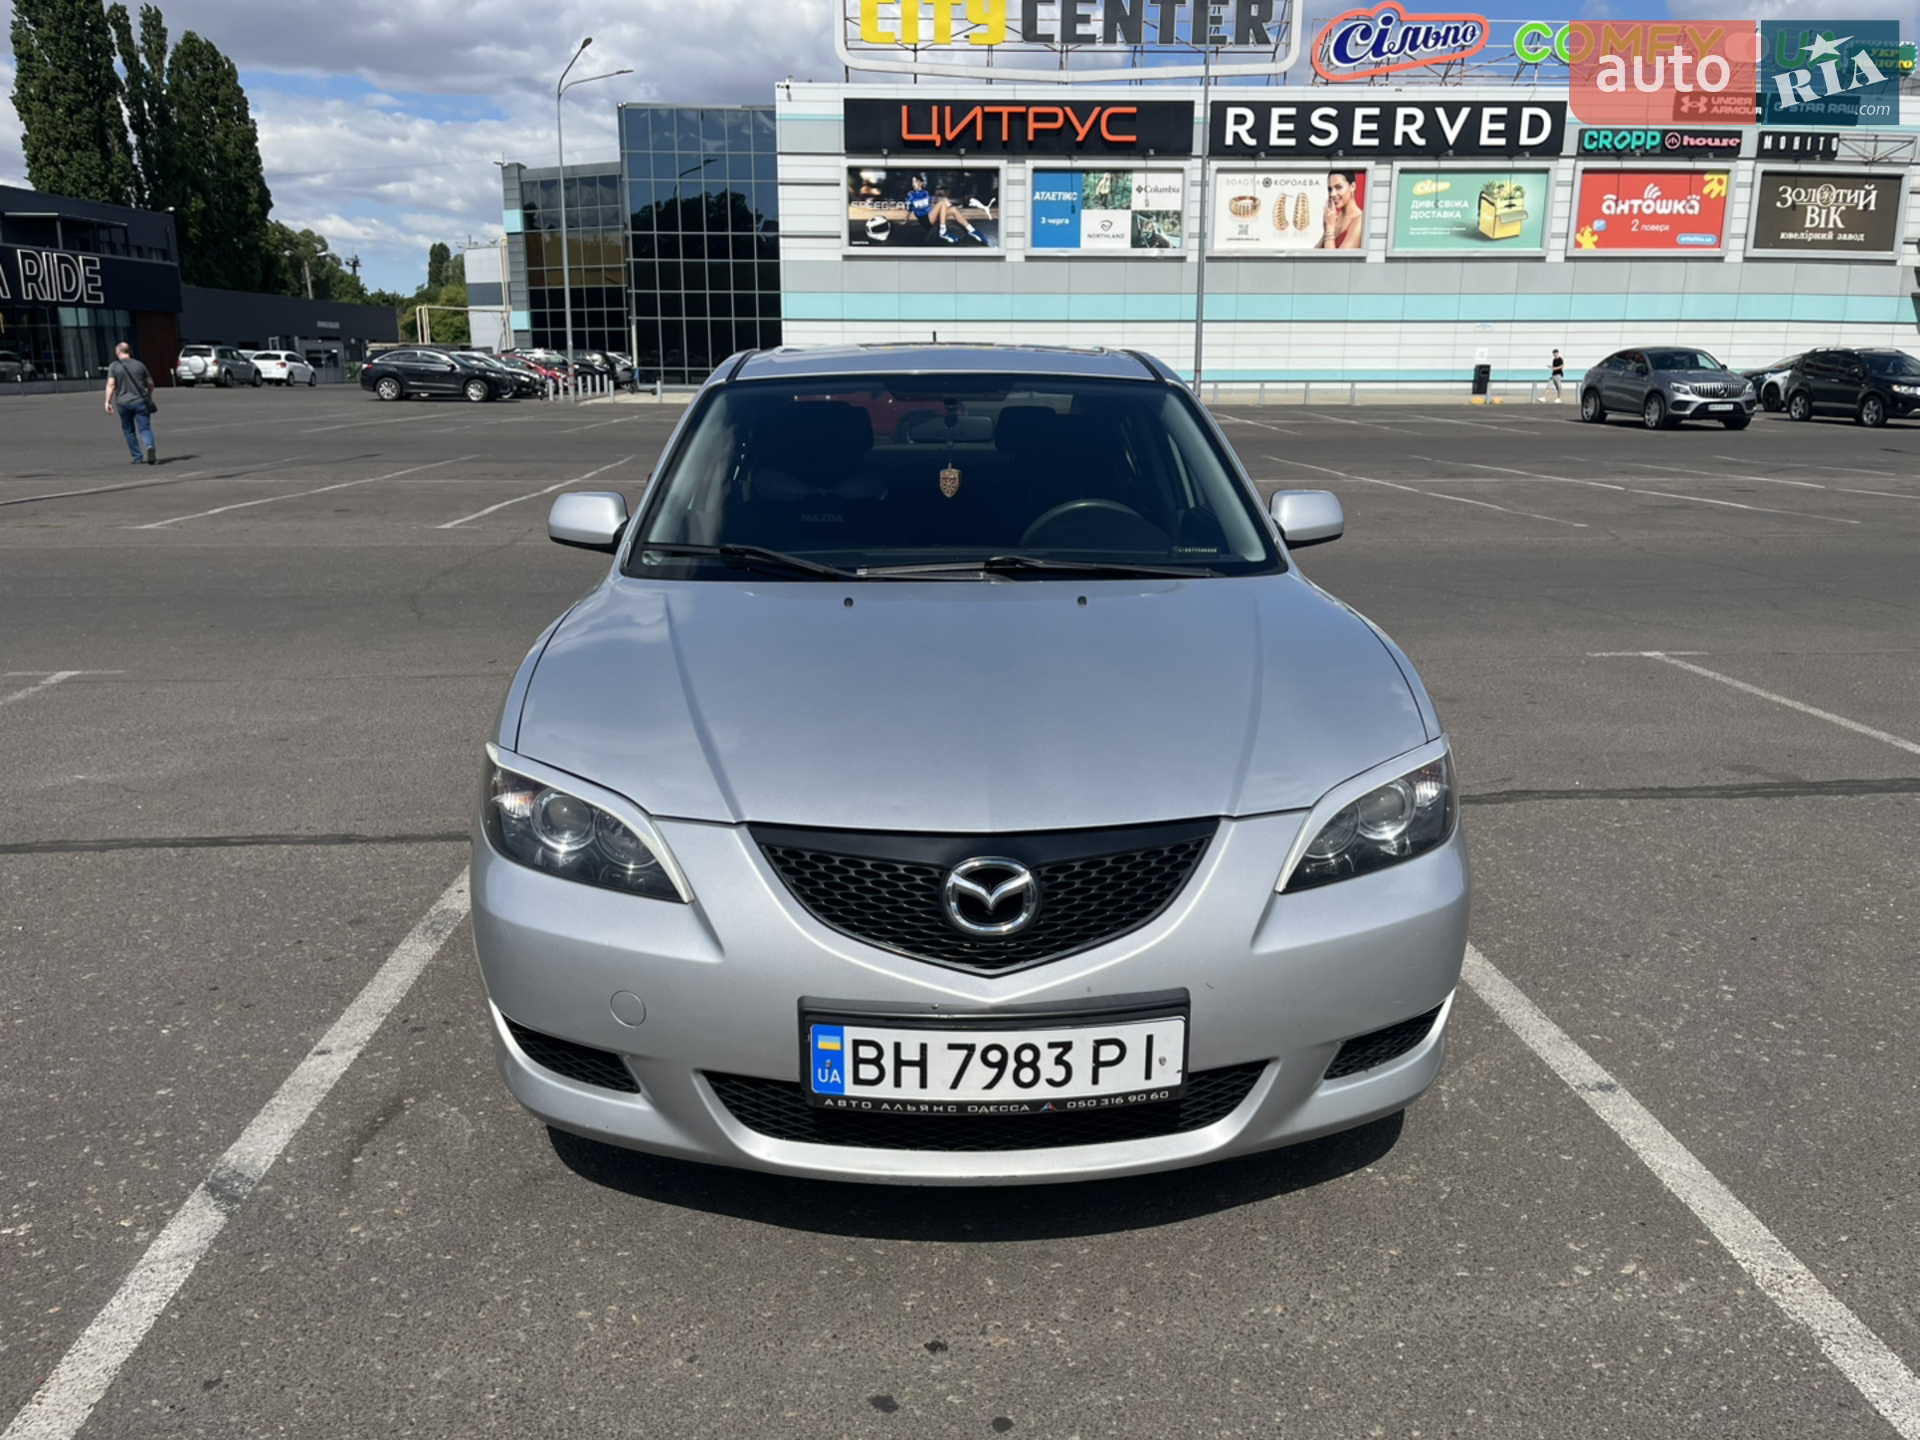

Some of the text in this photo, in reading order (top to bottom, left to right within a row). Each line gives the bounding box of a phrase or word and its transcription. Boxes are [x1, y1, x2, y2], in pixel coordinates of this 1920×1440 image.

[861, 0, 1274, 46] CITY CENTER
[1333, 14, 1479, 66] Сільпо
[1514, 21, 1725, 65] COMFY
[1711, 96, 1753, 106] UNDER
[1710, 106, 1762, 115] ARMOUR
[901, 105, 1138, 147] ЦИТРУС
[1224, 107, 1552, 147] RESERVED
[1583, 129, 1661, 150] CROPP
[1763, 135, 1839, 152] MOHITO
[1144, 185, 1180, 193] Columbia
[1274, 178, 1320, 186] КОРОЛЕВА
[1040, 216, 1046, 225] 3
[1410, 210, 1462, 220] ДОСТАВКА
[1631, 219, 1670, 233] 2 поверх
[1780, 230, 1865, 242] ювелірний завод
[17, 248, 104, 304] RIDE
[801, 513, 843, 522] MAZDA
[852, 1039, 928, 1089] BH
[946, 1041, 1073, 1090] 7983
[818, 1067, 842, 1084] UA
[824, 1090, 1169, 1114] АВТО АЛЬЯНС ОДЕССА 050 316 90 60
